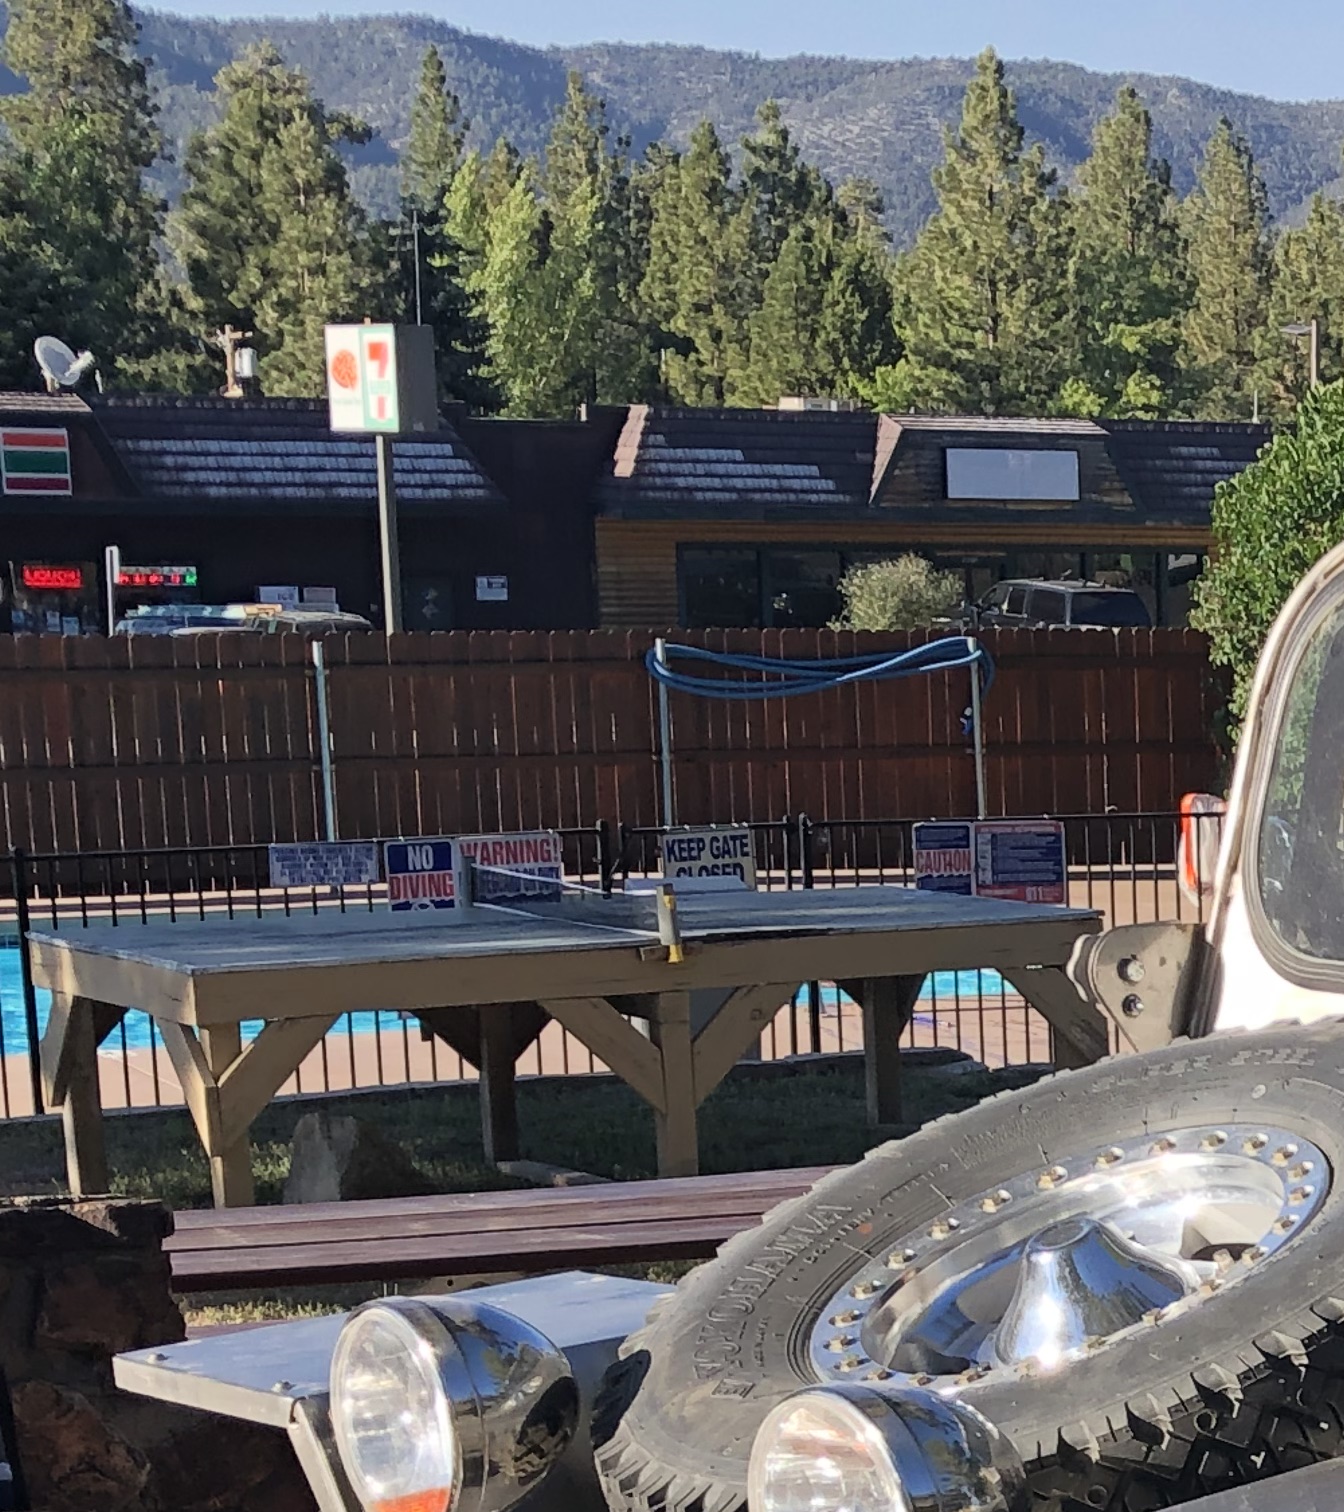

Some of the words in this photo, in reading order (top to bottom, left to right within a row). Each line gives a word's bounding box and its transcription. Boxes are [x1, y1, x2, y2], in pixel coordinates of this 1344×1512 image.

[407, 845, 433, 870] NO
[458, 838, 558, 865] WARNING!
[665, 838, 705, 863] KEEP
[710, 834, 750, 859] GATE
[916, 850, 971, 873] CAUTION
[390, 873, 454, 899] DIVING
